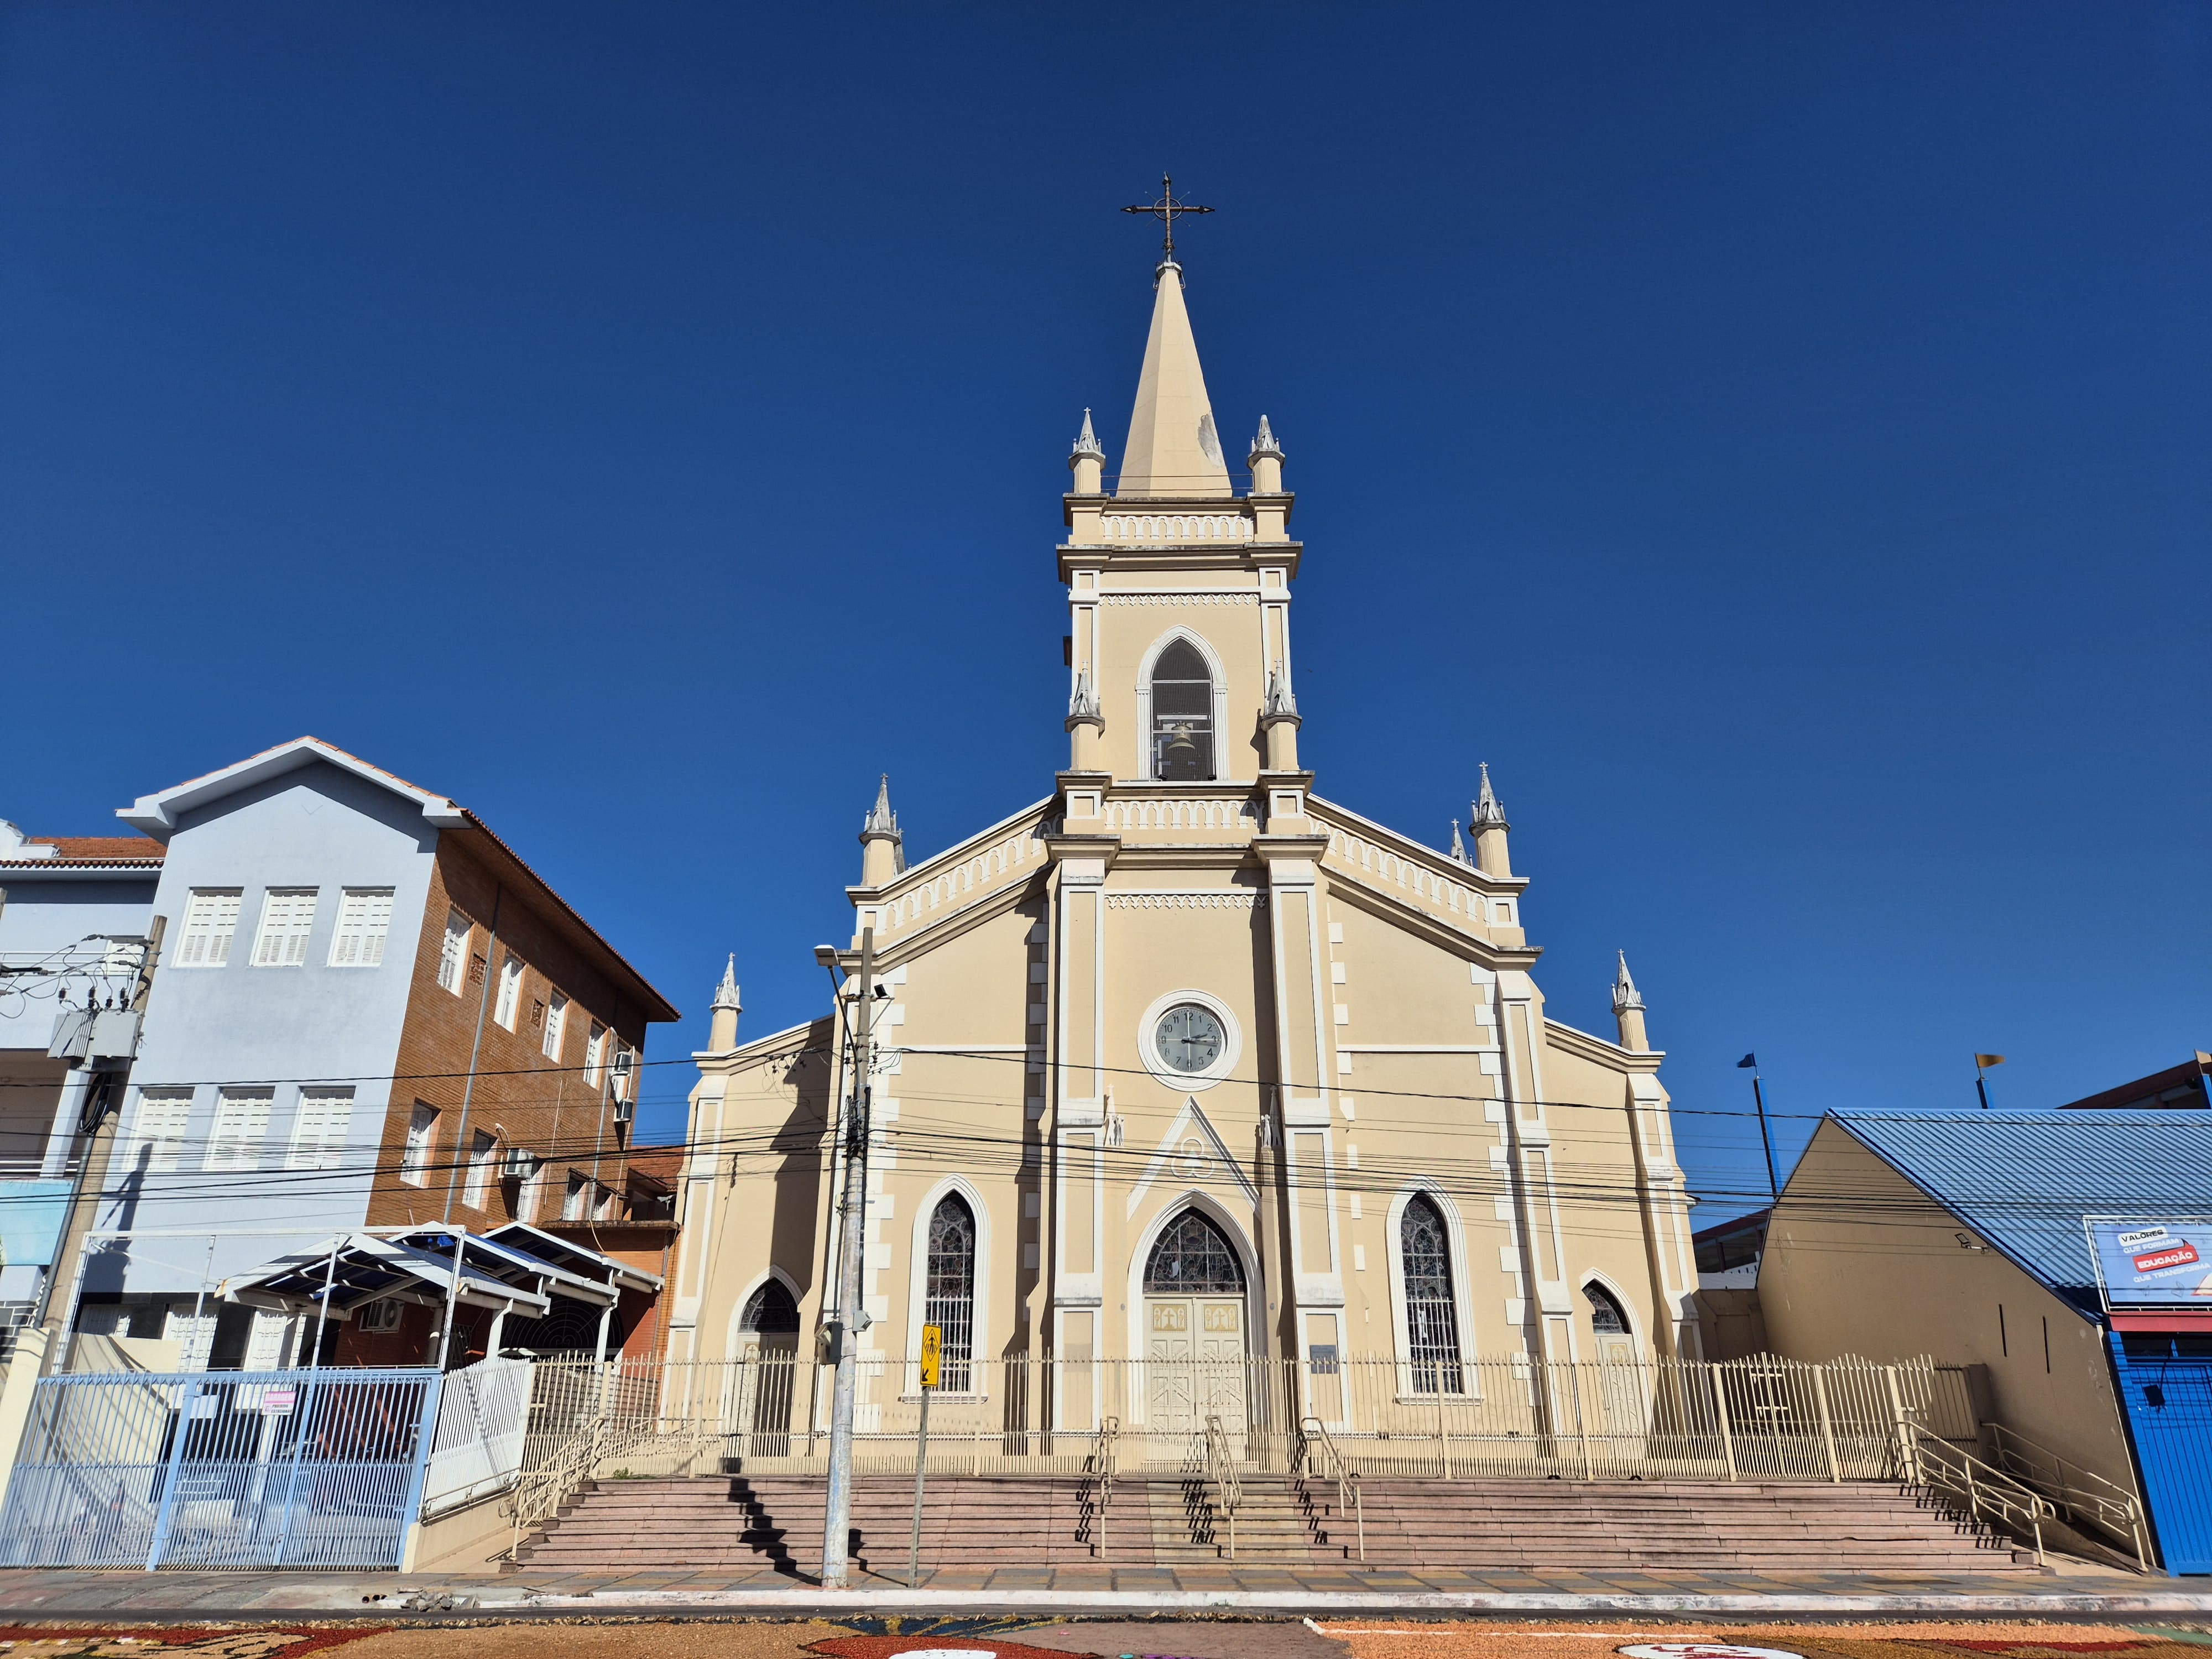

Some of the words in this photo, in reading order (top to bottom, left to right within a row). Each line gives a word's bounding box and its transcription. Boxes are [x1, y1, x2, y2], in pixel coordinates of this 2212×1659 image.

[1184, 1013, 1193, 1021] 12
[1164, 1024, 1172, 1032] 10
[1207, 1023, 1213, 1032] 2
[1161, 1035, 1166, 1044] 9
[1212, 1035, 1217, 1044] 3
[1165, 1047, 1170, 1057] 8
[1207, 1047, 1213, 1057] 4
[1176, 1056, 1182, 1065] 7
[1186, 1059, 1192, 1068] 6
[1198, 1056, 1204, 1065] 5
[2121, 1229, 2164, 1242] VALORES
[2123, 1246, 2142, 1254] QUE
[2142, 1238, 2179, 1250] FORMAM
[2137, 1250, 2193, 1269] EDUCAÇÃO
[2133, 1274, 2152, 1283] QUE
[2152, 1262, 2211, 1279] TRANSFORMA
